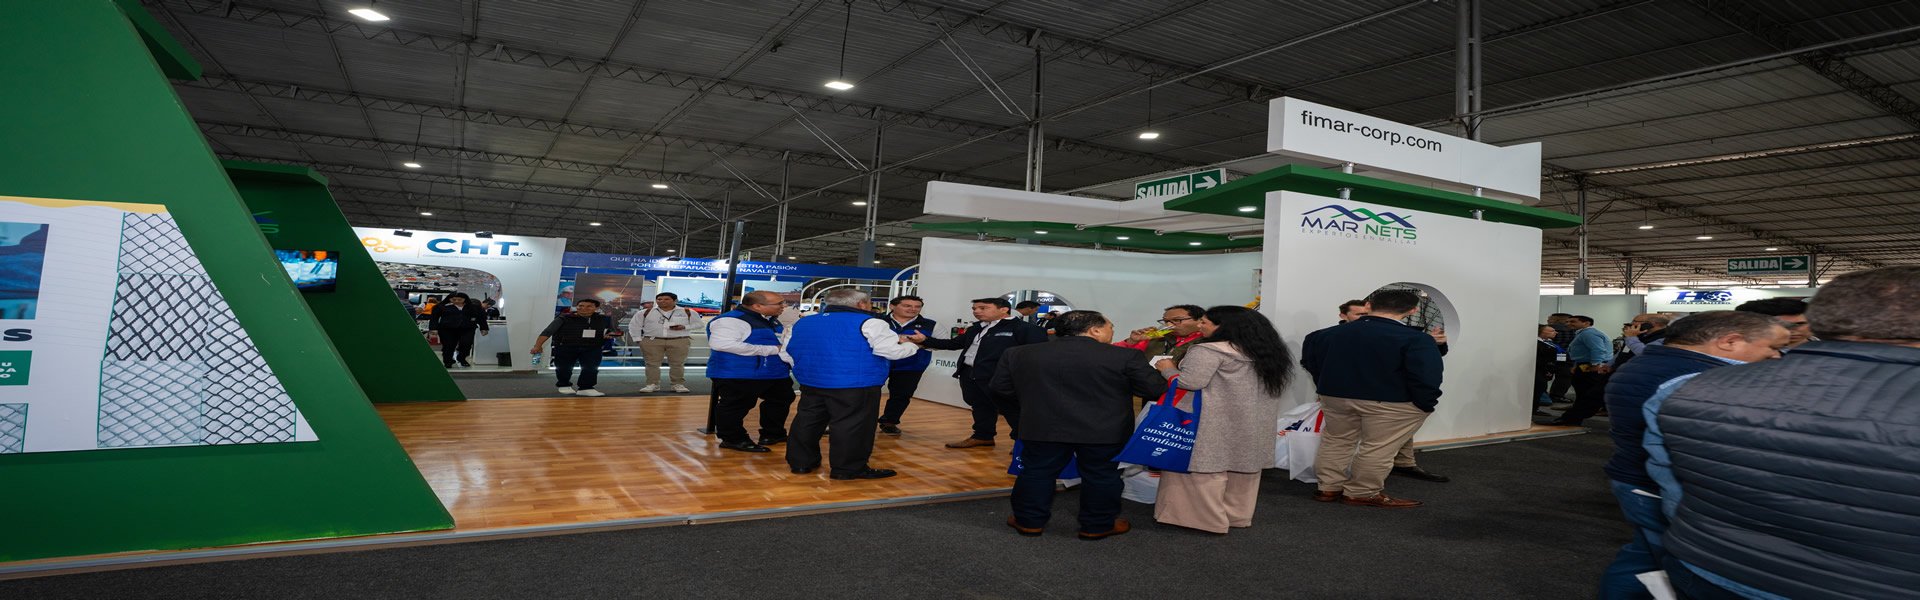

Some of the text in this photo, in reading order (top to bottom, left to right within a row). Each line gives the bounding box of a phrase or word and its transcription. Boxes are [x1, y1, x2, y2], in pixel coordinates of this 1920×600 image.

[1301, 110, 1442, 152] fimar-corp.com
[1137, 181, 1188, 200] SALIDA
[1301, 216, 1417, 240] MAR NETS
[1302, 228, 1358, 239] EXPERTOS
[427, 238, 519, 256] CHT
[1729, 259, 1779, 270] SALIDA
[935, 359, 957, 368] FIMA
[1159, 421, 1174, 429] 30
[1141, 435, 1192, 451] confianza
[1143, 427, 1195, 443] onstruyen
